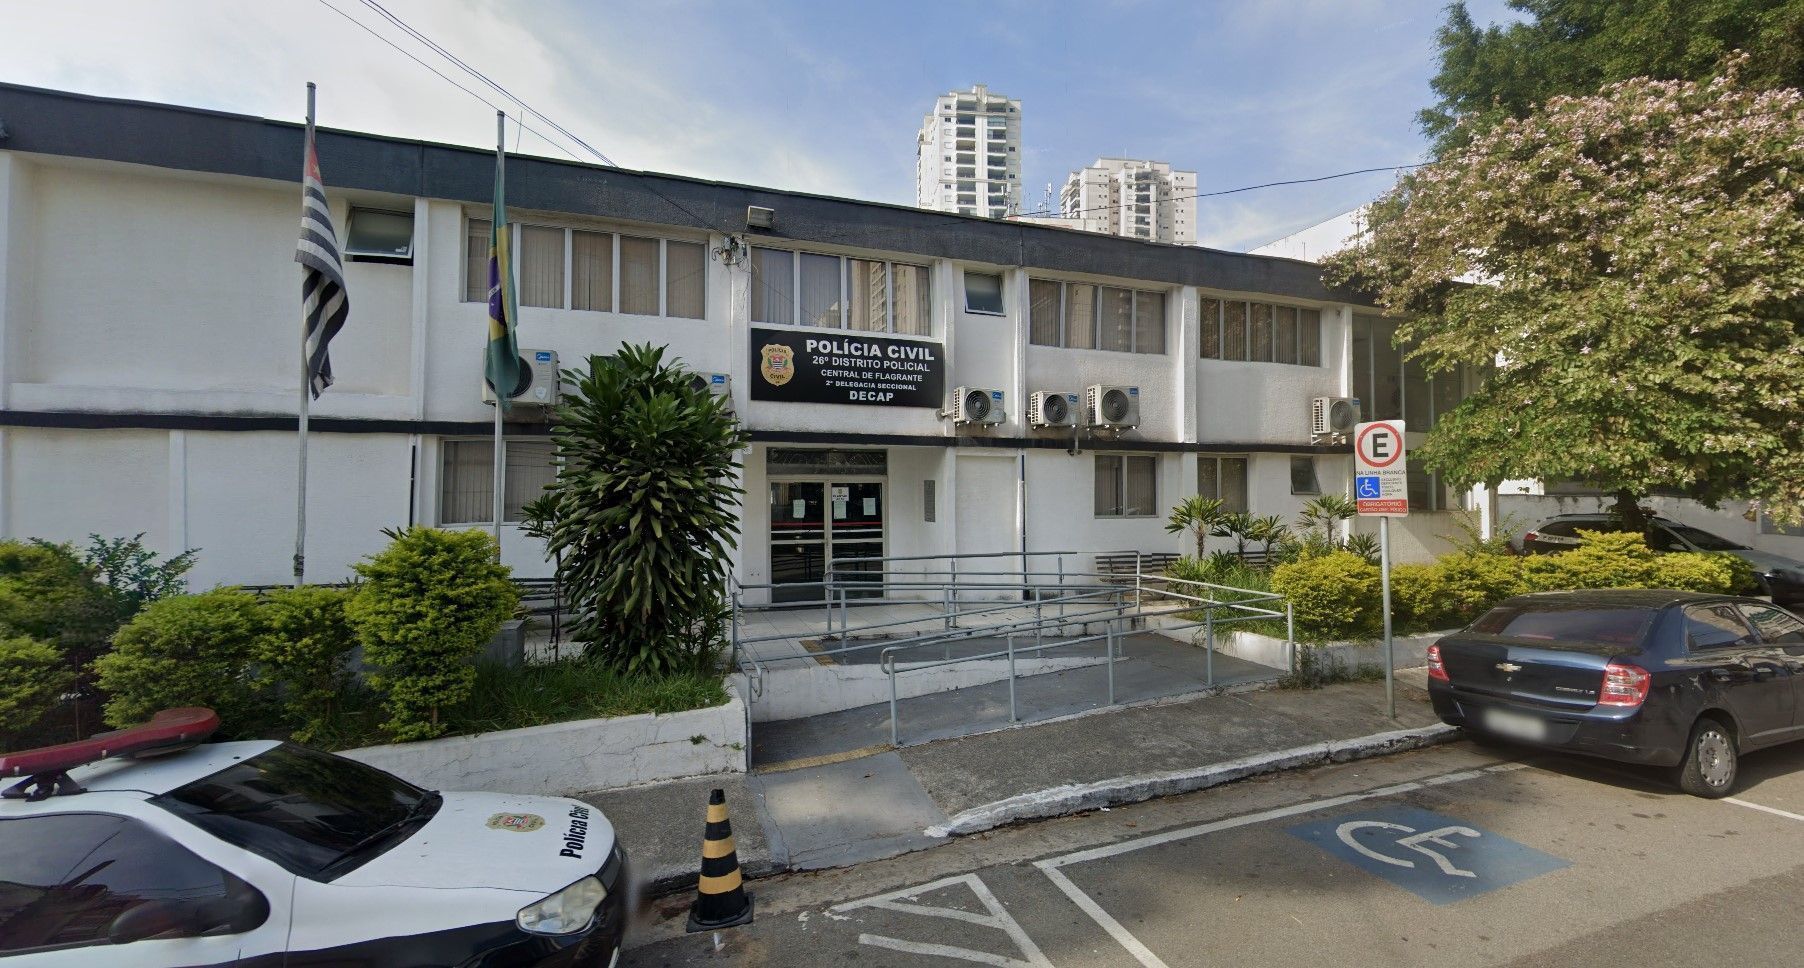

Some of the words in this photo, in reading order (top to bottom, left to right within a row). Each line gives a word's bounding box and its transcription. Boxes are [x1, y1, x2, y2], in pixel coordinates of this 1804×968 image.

[806, 339, 882, 357] POLÍCIA
[887, 345, 935, 361] CIVIL
[832, 357, 881, 369] DISTRITO
[883, 360, 931, 372] POLICIAL
[821, 369, 860, 379] CENTRAL
[862, 371, 874, 379] DE
[875, 372, 923, 382] FLAGRANTE
[835, 380, 876, 389] DELEGACIA
[877, 382, 917, 391] SECCIONAL
[849, 390, 894, 402] DECAP
[1372, 432, 1389, 458] E
[559, 819, 588, 860] Polícia
